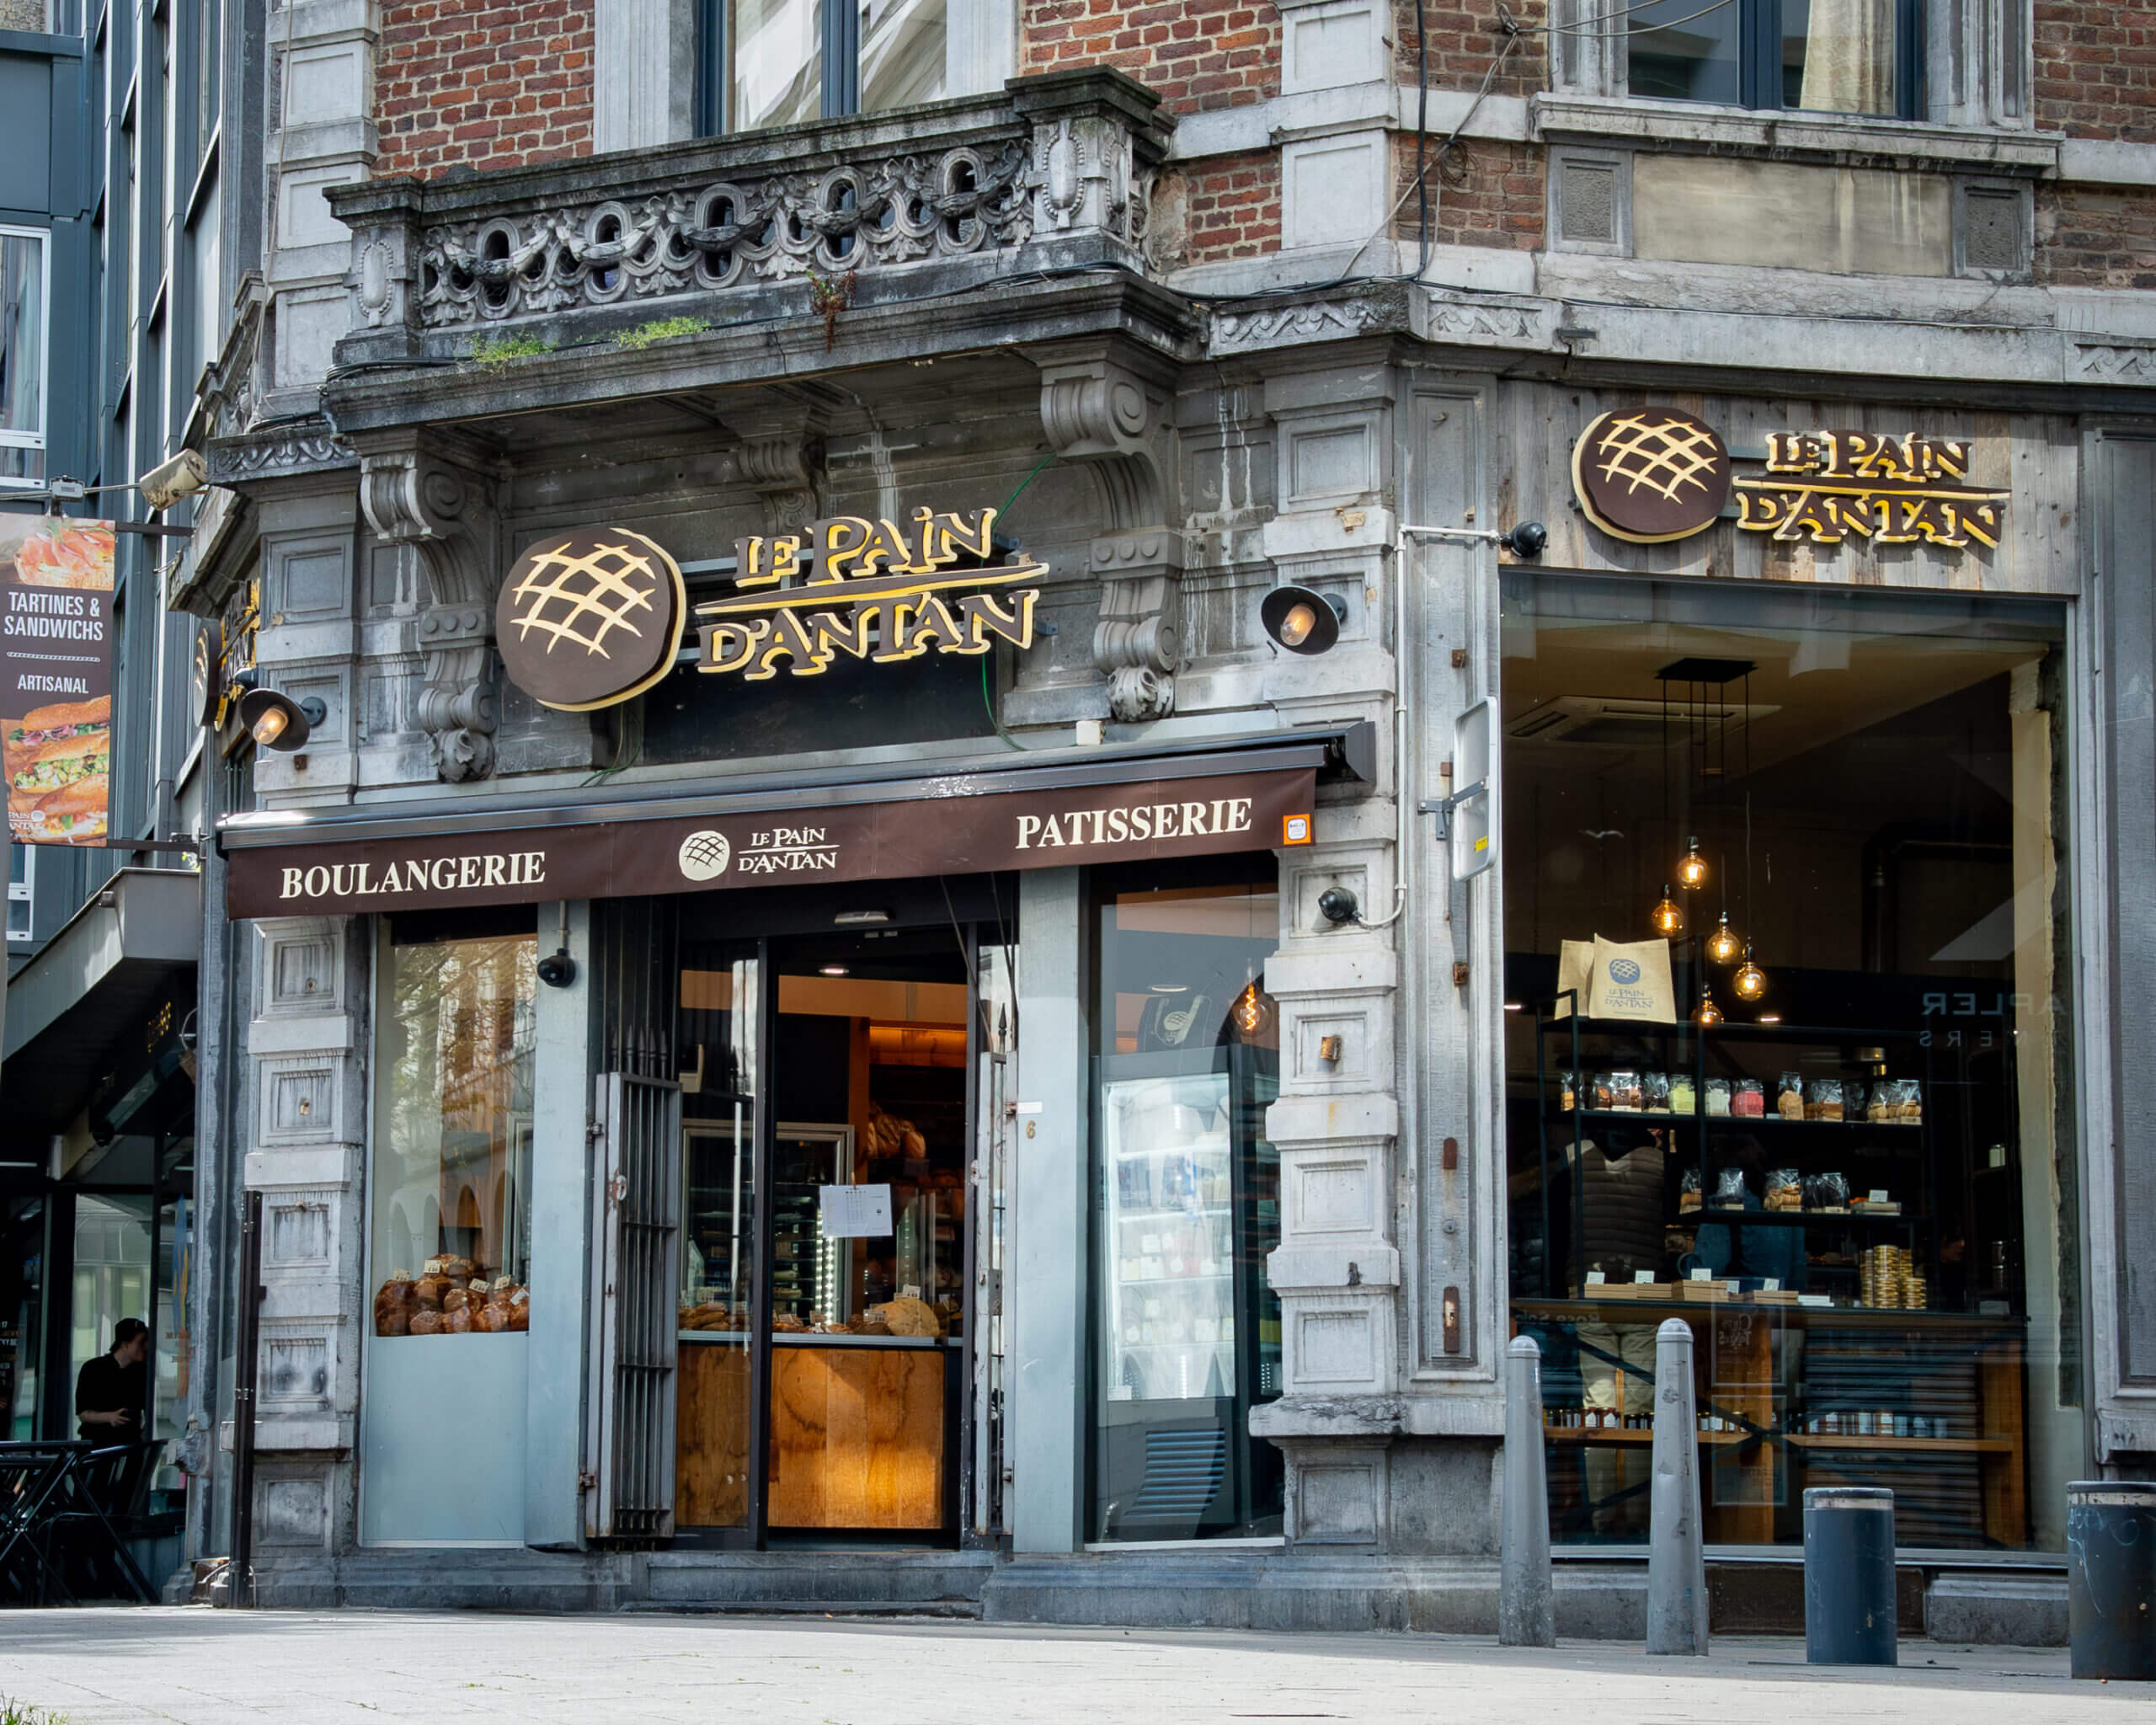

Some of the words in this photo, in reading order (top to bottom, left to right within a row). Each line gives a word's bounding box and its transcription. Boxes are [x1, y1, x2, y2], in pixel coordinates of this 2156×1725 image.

[1765, 432, 1822, 472] LE
[1736, 489, 2007, 550] D'ANTAN
[734, 536, 800, 588] LE
[8, 591, 84, 616] TARTINES
[89, 597, 100, 617] &
[3, 615, 104, 641] SANDWICHS
[695, 589, 1040, 681] D'ANTAN
[17, 674, 90, 694] ARTISANAL
[750, 832, 771, 846] LE
[1015, 798, 1252, 849] PATISSERIE
[279, 852, 546, 899] BOULANGERIE
[738, 852, 837, 873] D'ANTAN
[1026, 1119, 1036, 1140] 6
